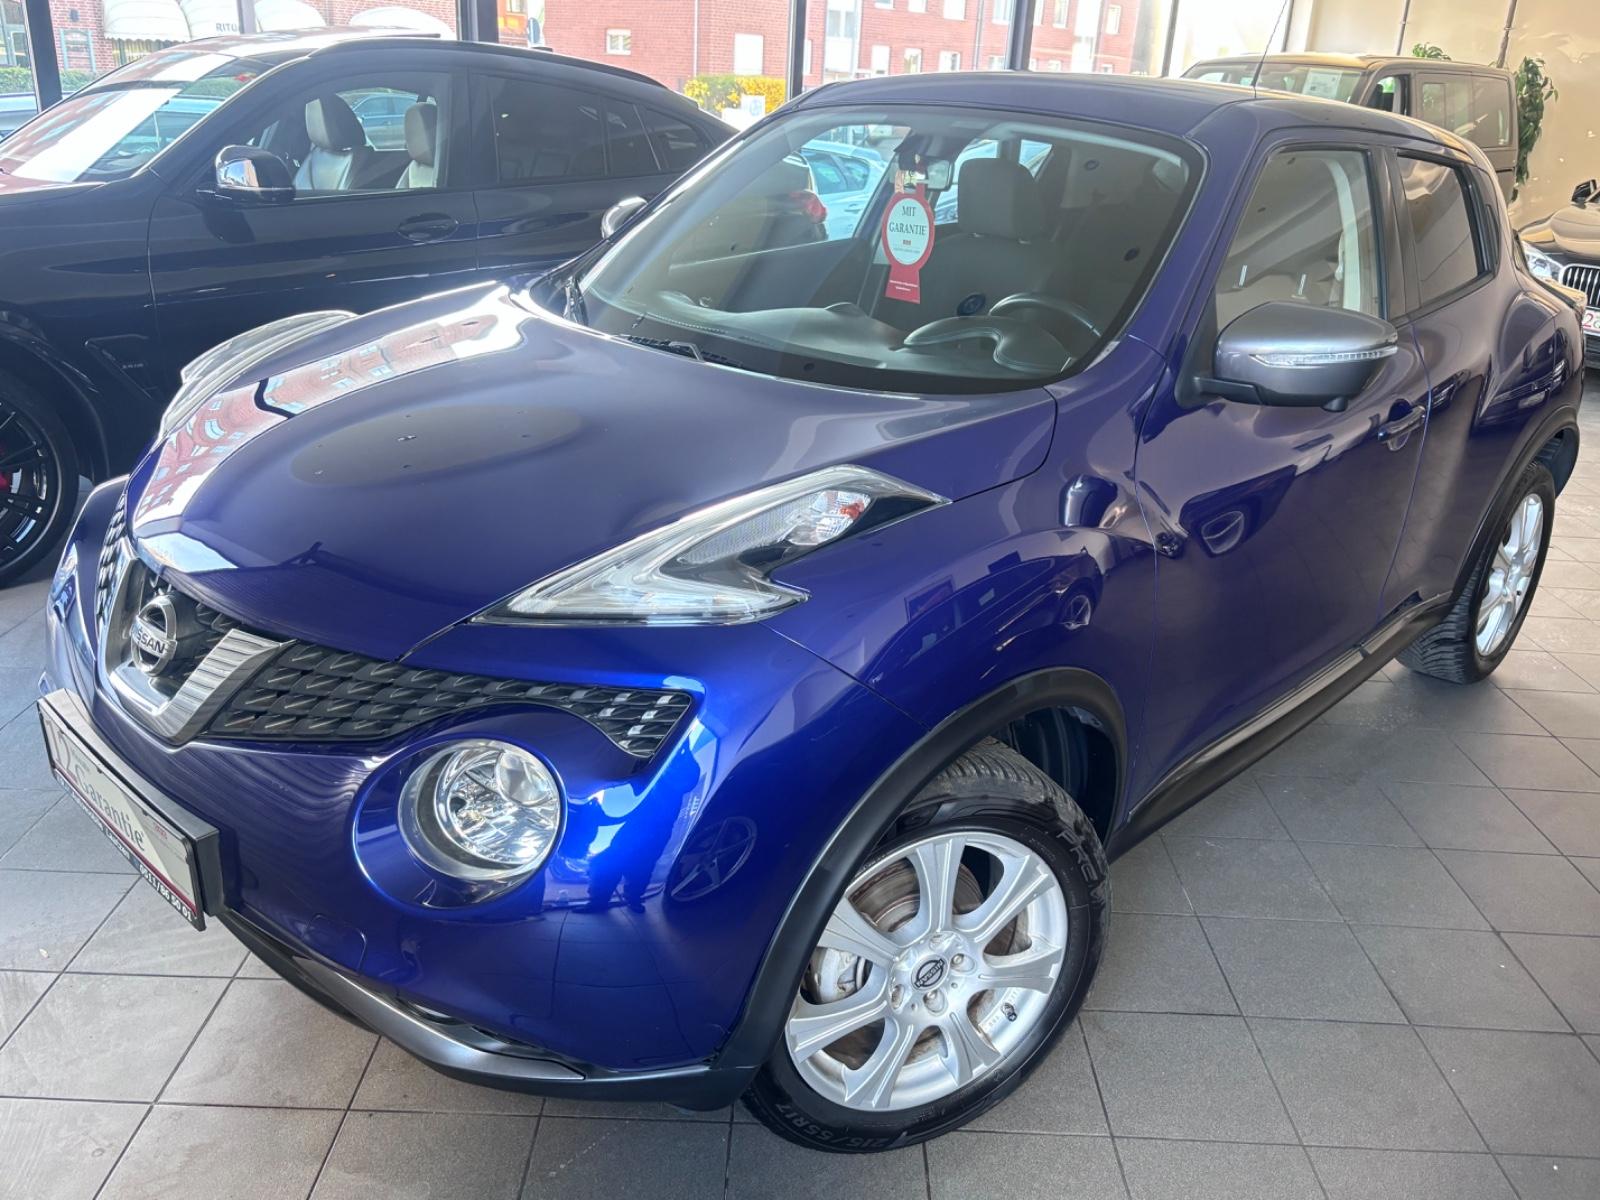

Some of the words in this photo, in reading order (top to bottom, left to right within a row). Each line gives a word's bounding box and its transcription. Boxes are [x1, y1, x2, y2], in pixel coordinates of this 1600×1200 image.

[215, 22, 238, 32] RITU
[902, 206, 916, 217] MIT
[889, 222, 927, 235] GARANTIE
